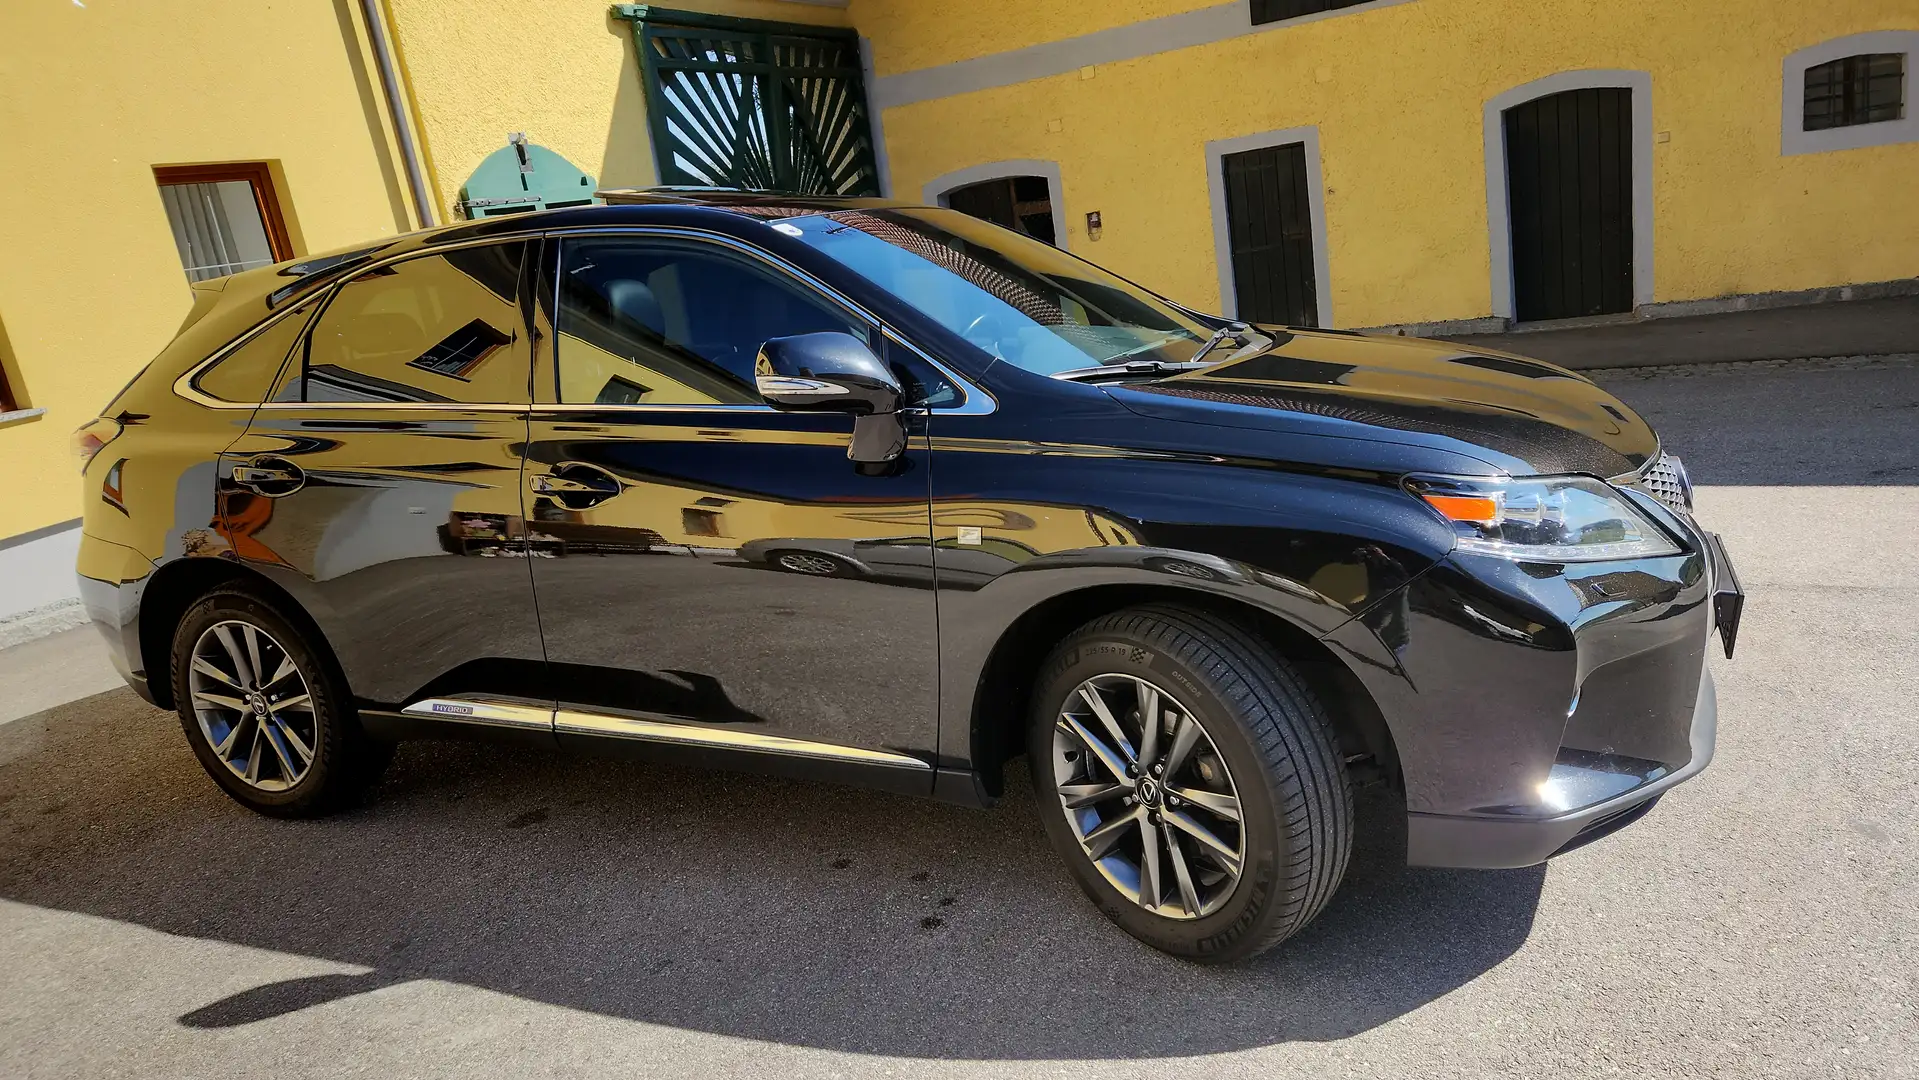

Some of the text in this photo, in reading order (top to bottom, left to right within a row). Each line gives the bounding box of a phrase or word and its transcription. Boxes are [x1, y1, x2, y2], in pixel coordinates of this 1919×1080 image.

[1118, 647, 1126, 656] 19
[1171, 670, 1202, 698] OUTSIDE
[313, 683, 332, 764] MICHELIN
[436, 705, 468, 714] HYBRID
[1200, 886, 1267, 953] MICHELIN
